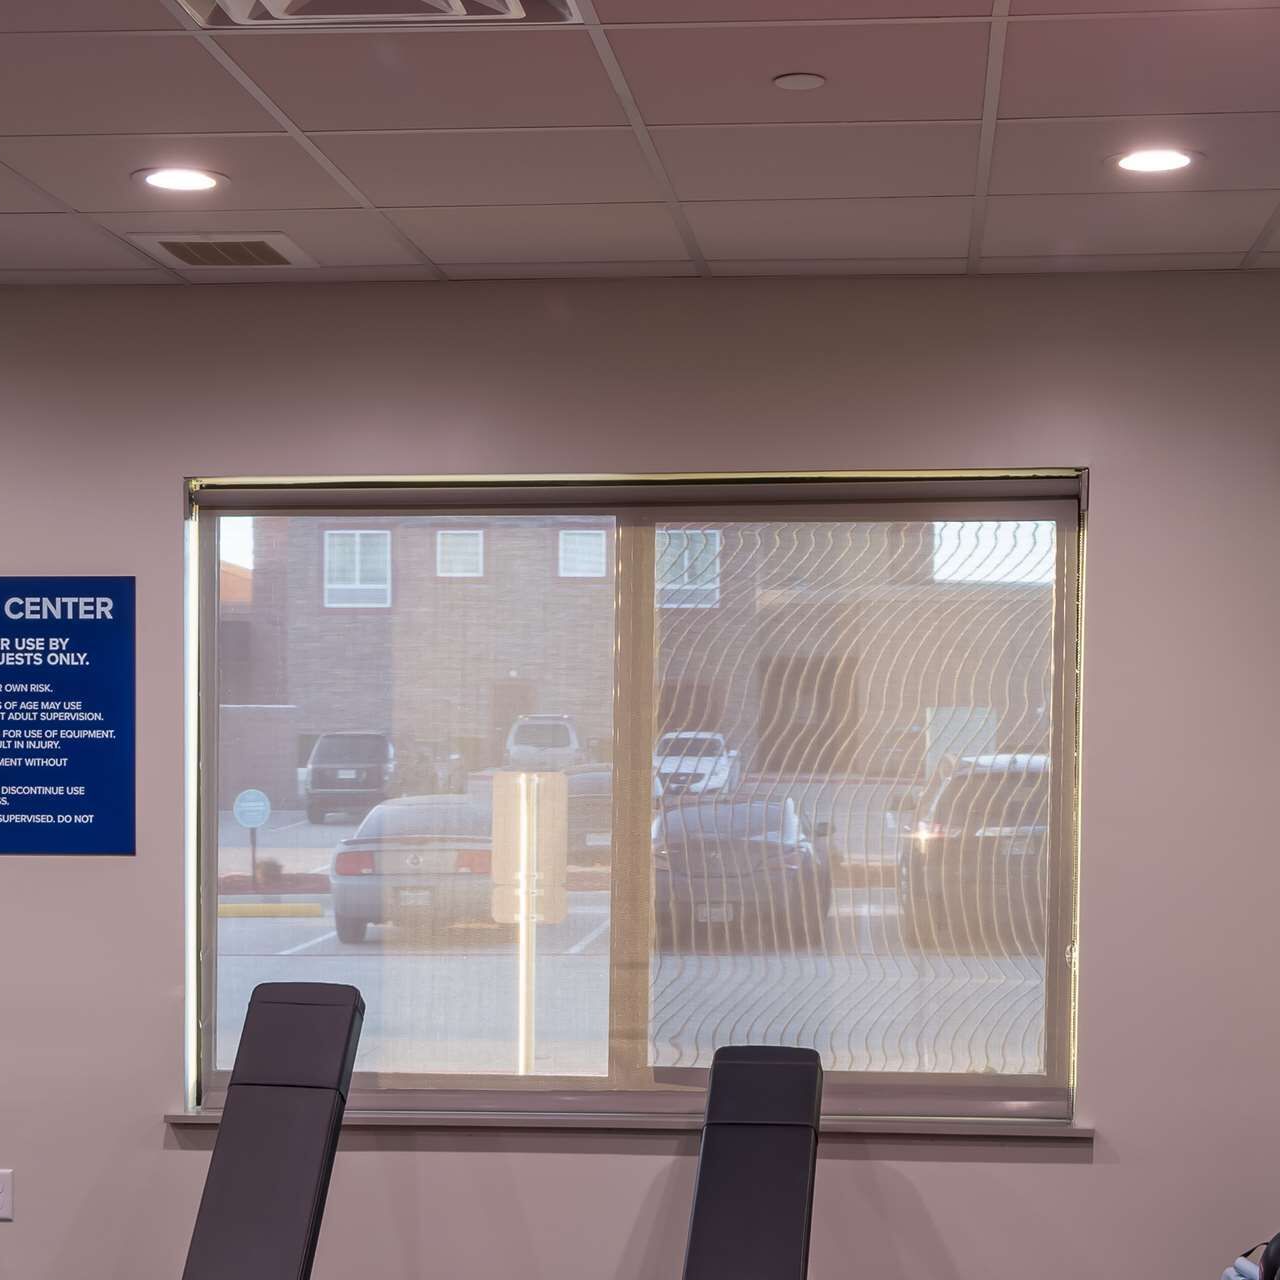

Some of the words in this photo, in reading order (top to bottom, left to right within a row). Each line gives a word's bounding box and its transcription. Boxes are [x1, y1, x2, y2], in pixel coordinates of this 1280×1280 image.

[4, 596, 114, 620] CENTER
[14, 637, 45, 651] USE
[48, 637, 70, 651] BY
[46, 652, 90, 666] ONLY.
[4, 682, 29, 693] OWN
[29, 682, 54, 693] RISK.
[3, 700, 18, 711] OF
[19, 700, 39, 711] AGE
[40, 700, 62, 711] MAY
[63, 700, 83, 711] USE
[7, 711, 39, 721] ADULT
[39, 711, 104, 721] SUPERVISION.
[2, 728, 23, 739] FOR
[23, 728, 43, 739] USE
[44, 728, 58, 739] OF
[59, 728, 116, 739] EQUIPMENT.
[13, 739, 25, 750] IN
[25, 739, 61, 750] INJURY.
[24, 757, 69, 767] WITHOUT
[1, 785, 65, 796] DISCONTINUE
[66, 785, 85, 796] USE
[57, 813, 73, 824] DO
[73, 813, 95, 824] NOT
